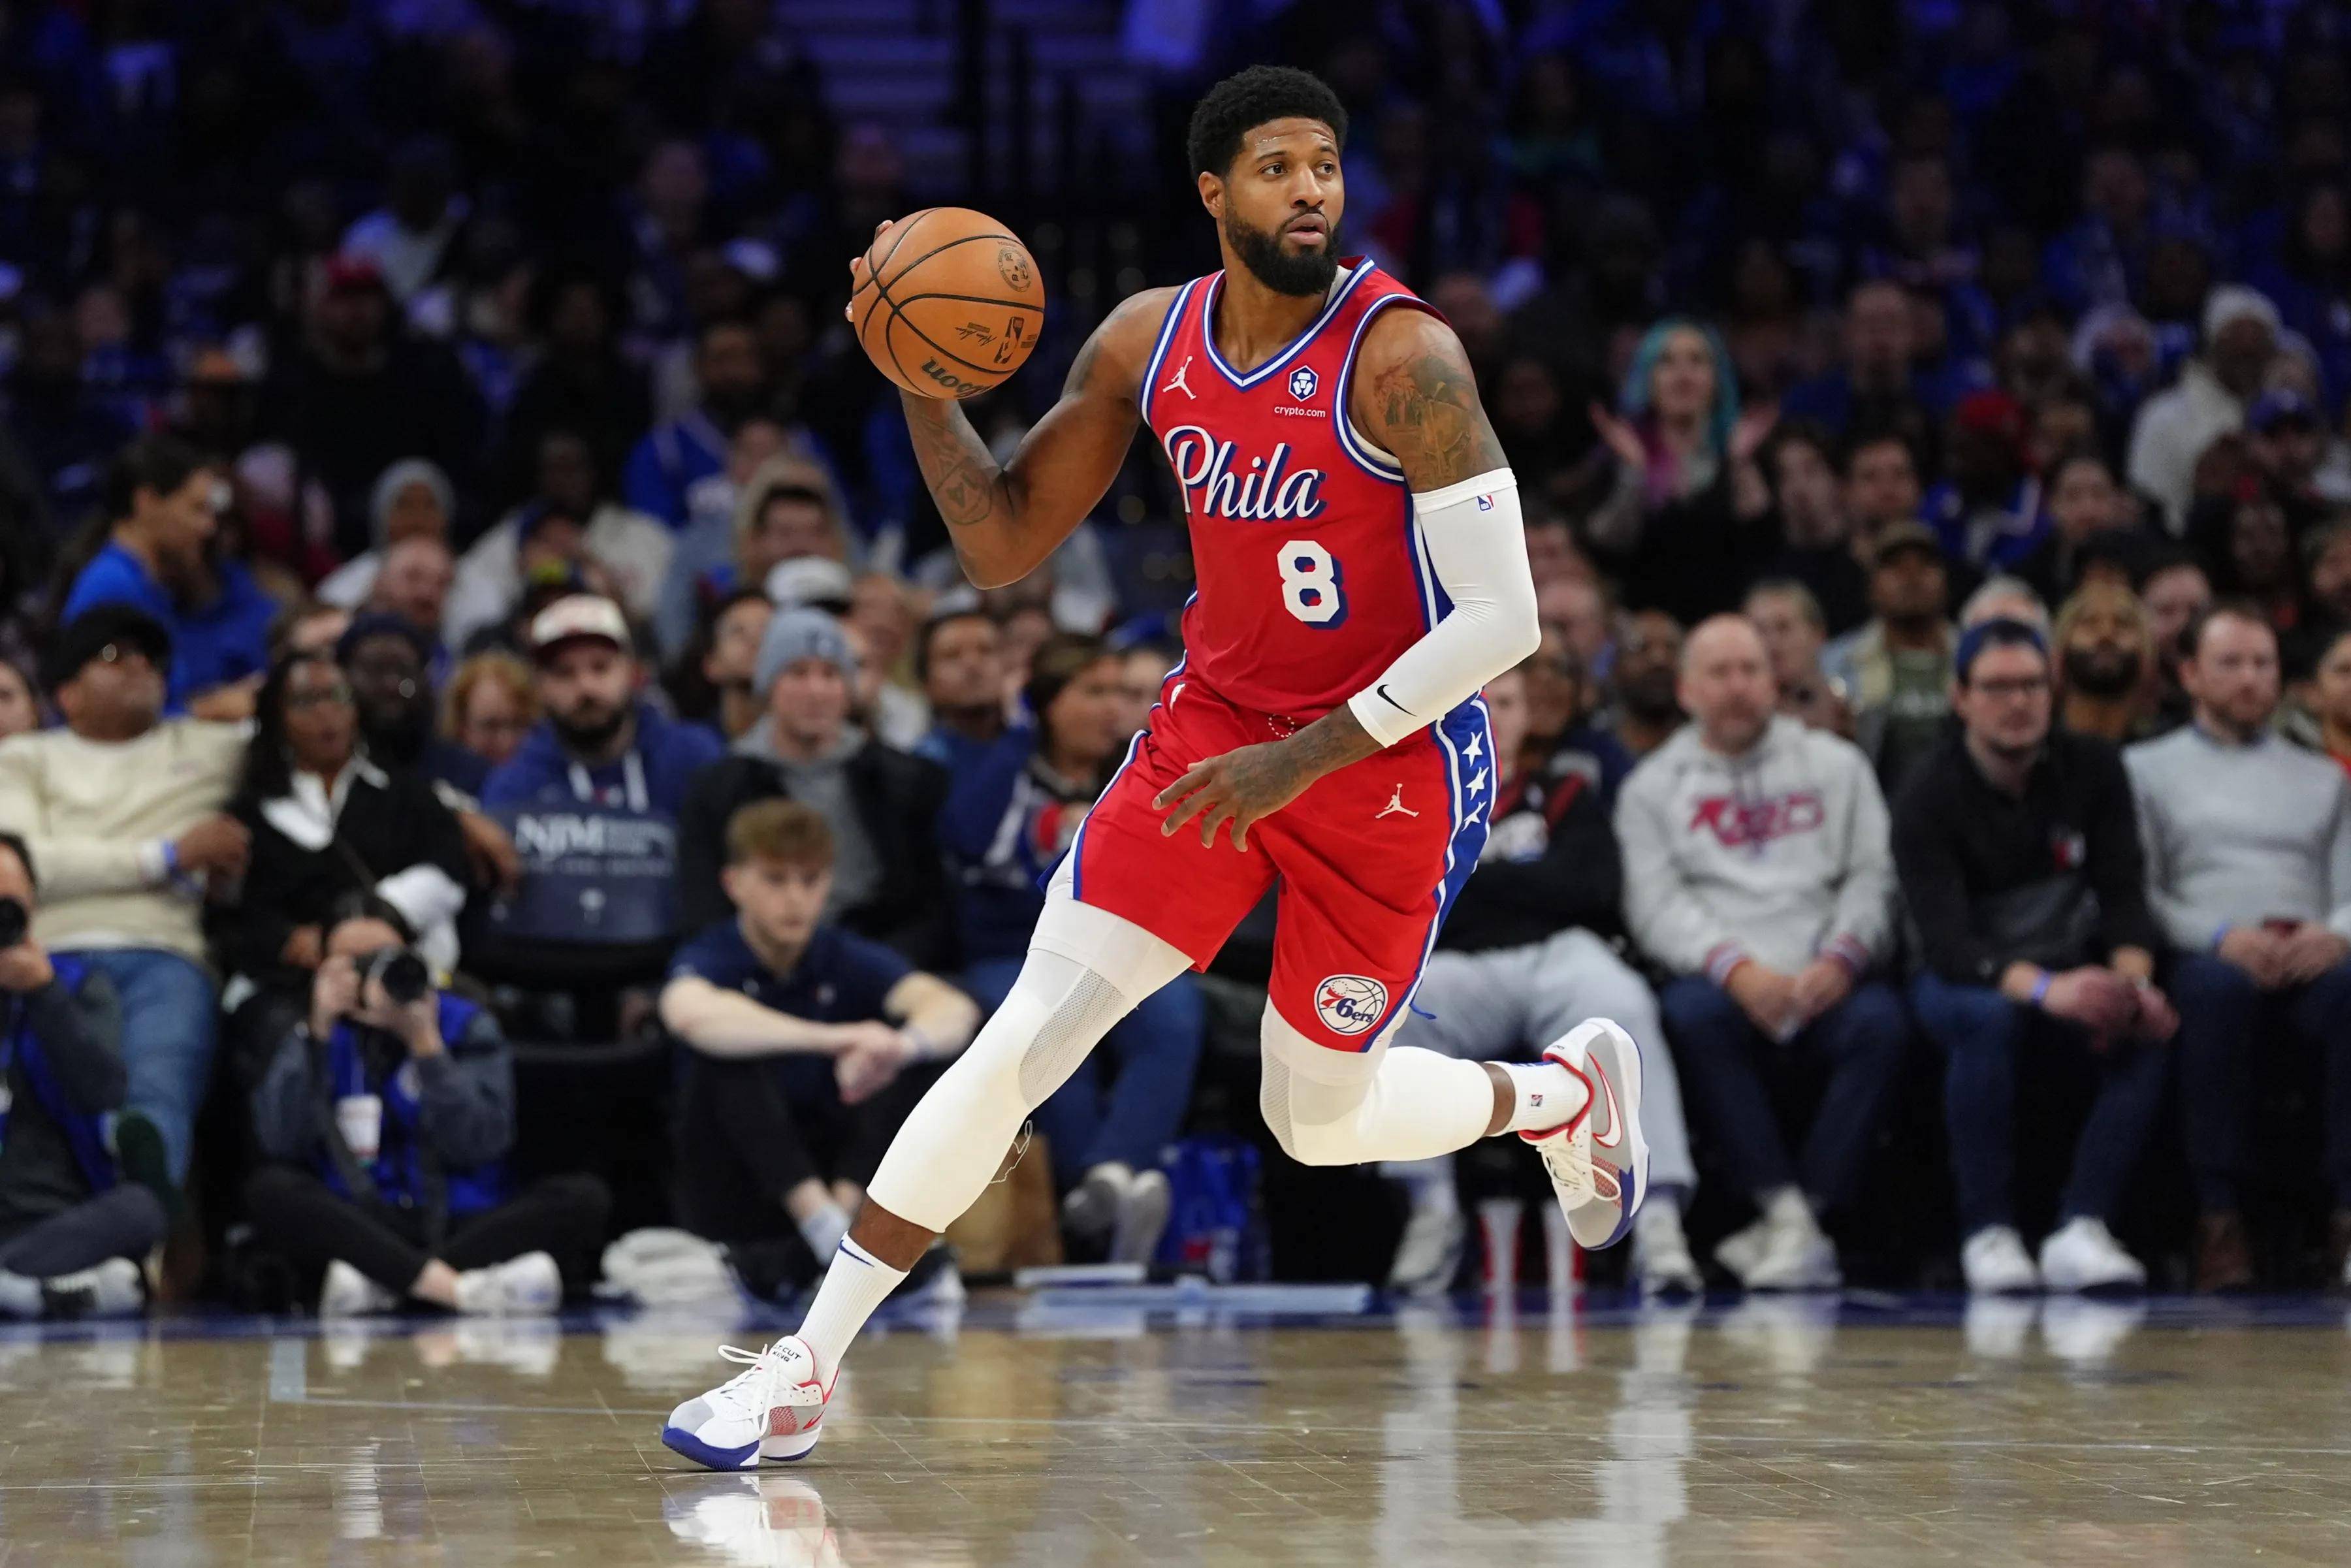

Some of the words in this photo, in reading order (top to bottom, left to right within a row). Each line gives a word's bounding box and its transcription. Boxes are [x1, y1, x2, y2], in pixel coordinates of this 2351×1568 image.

[1274, 406, 1326, 417] crypto.com
[1163, 425, 1325, 520] Phila
[1277, 540, 1345, 627] 8
[1320, 987, 1374, 1023] 76ers
[782, 1347, 802, 1359] CUT
